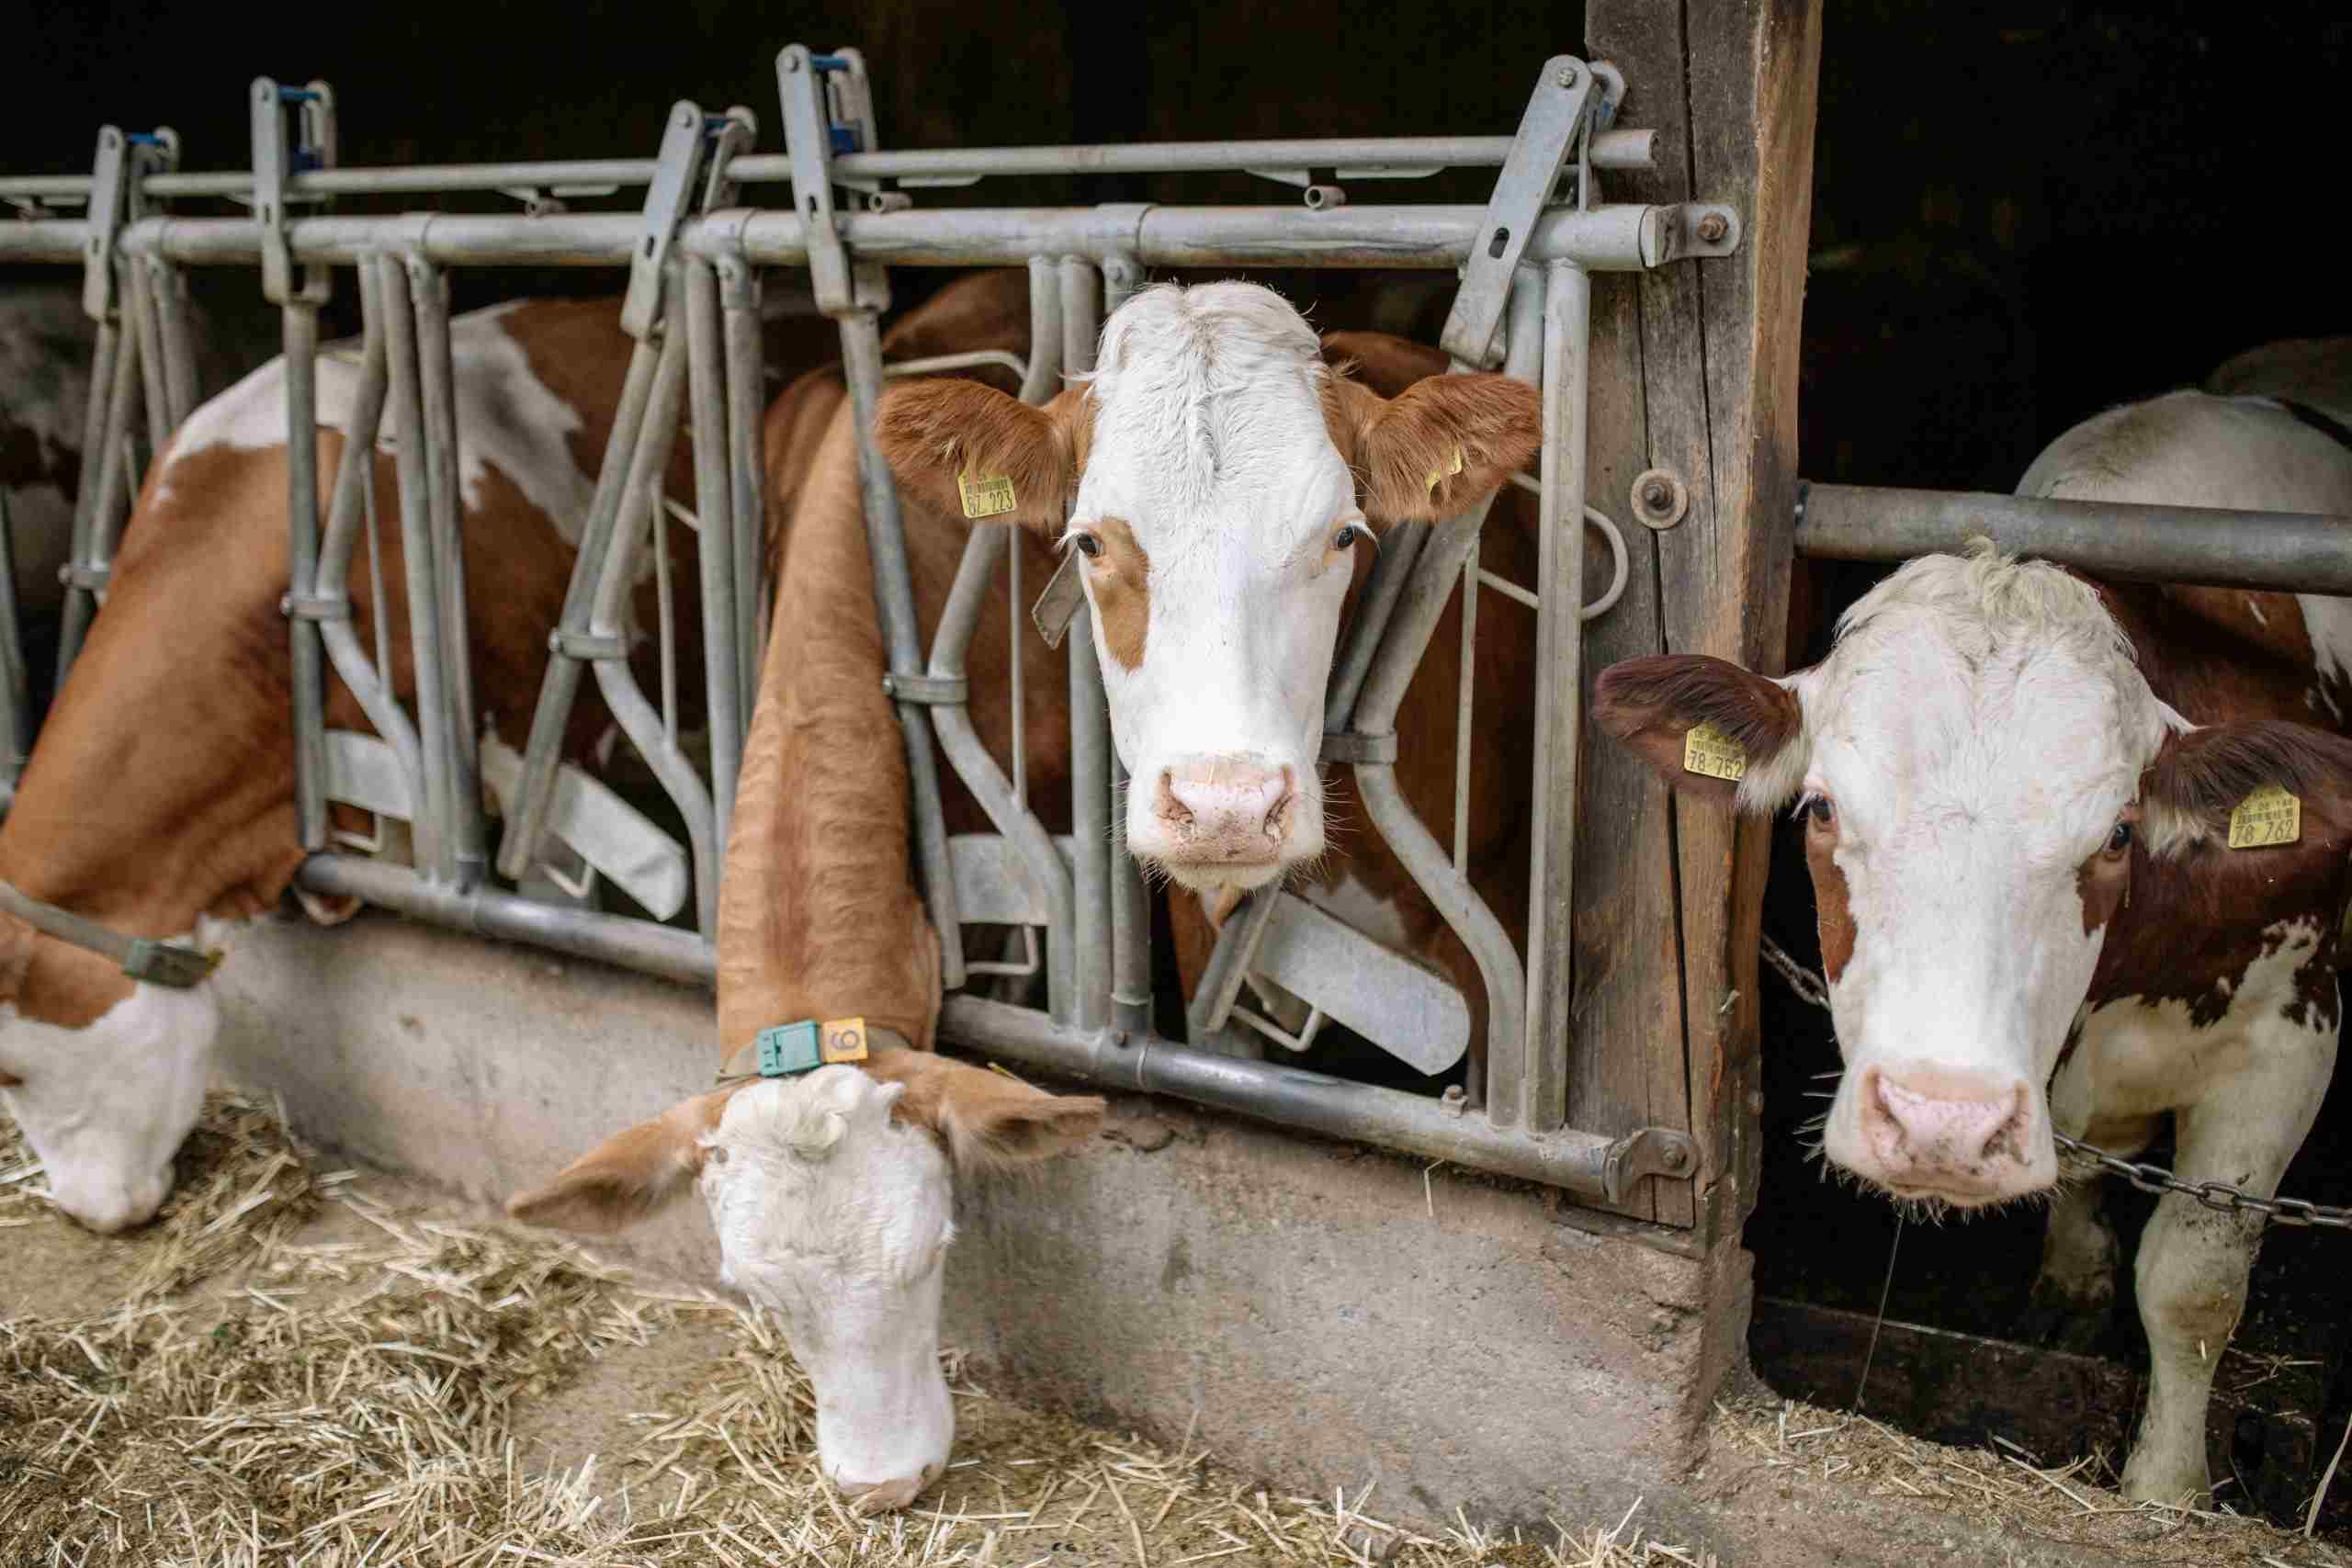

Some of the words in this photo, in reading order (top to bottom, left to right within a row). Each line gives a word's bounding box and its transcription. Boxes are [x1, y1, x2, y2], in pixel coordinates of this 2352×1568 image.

[989, 489, 1013, 513] 223
[1689, 750, 1706, 772] 78
[1715, 756, 1743, 780] 762
[2234, 824, 2255, 845] 78
[2265, 818, 2294, 842] 762
